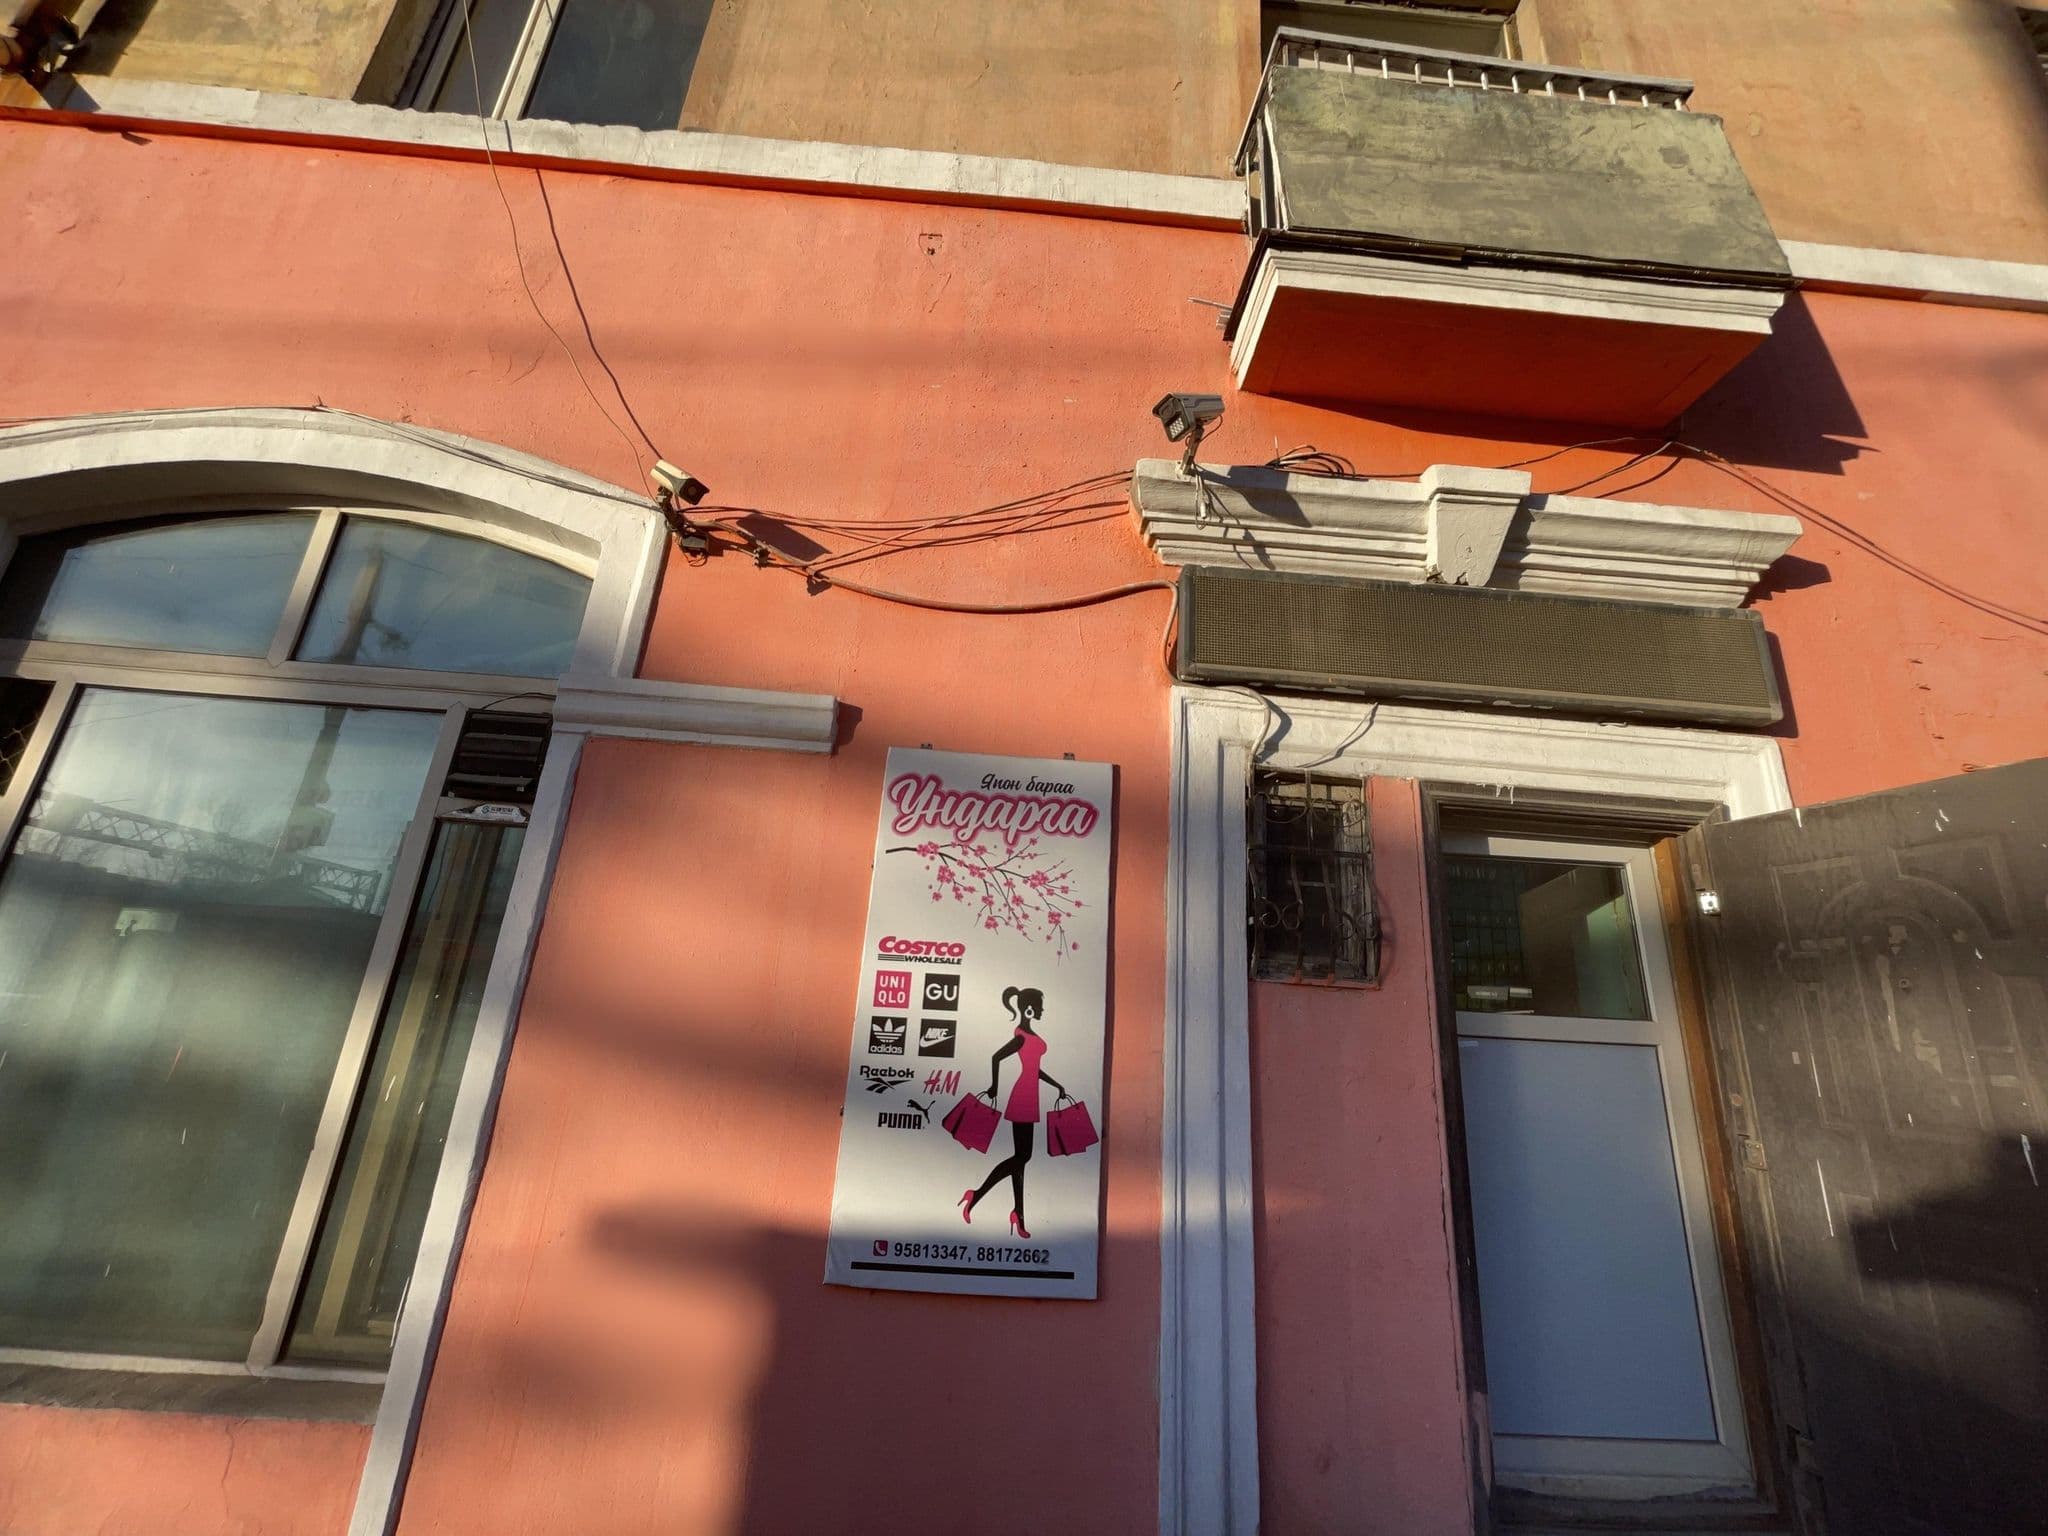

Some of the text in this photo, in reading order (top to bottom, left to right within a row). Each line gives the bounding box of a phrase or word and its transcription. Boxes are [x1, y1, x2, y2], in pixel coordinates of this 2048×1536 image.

[1026, 776, 1075, 797] бараа
[889, 775, 1097, 846] Ундарга
[878, 935, 966, 957] COSTCO
[904, 955, 962, 965] WHOLESALE
[880, 975, 905, 989] UNI
[878, 990, 906, 1005] QLO
[925, 983, 958, 1001] GU
[924, 1027, 949, 1039] NIKE
[870, 1044, 903, 1054] adidas
[859, 1065, 915, 1078] Reebok
[923, 1069, 961, 1096] H&M
[878, 1112, 922, 1130] PUMA
[894, 1242, 1050, 1265] 95813347, 88172662
